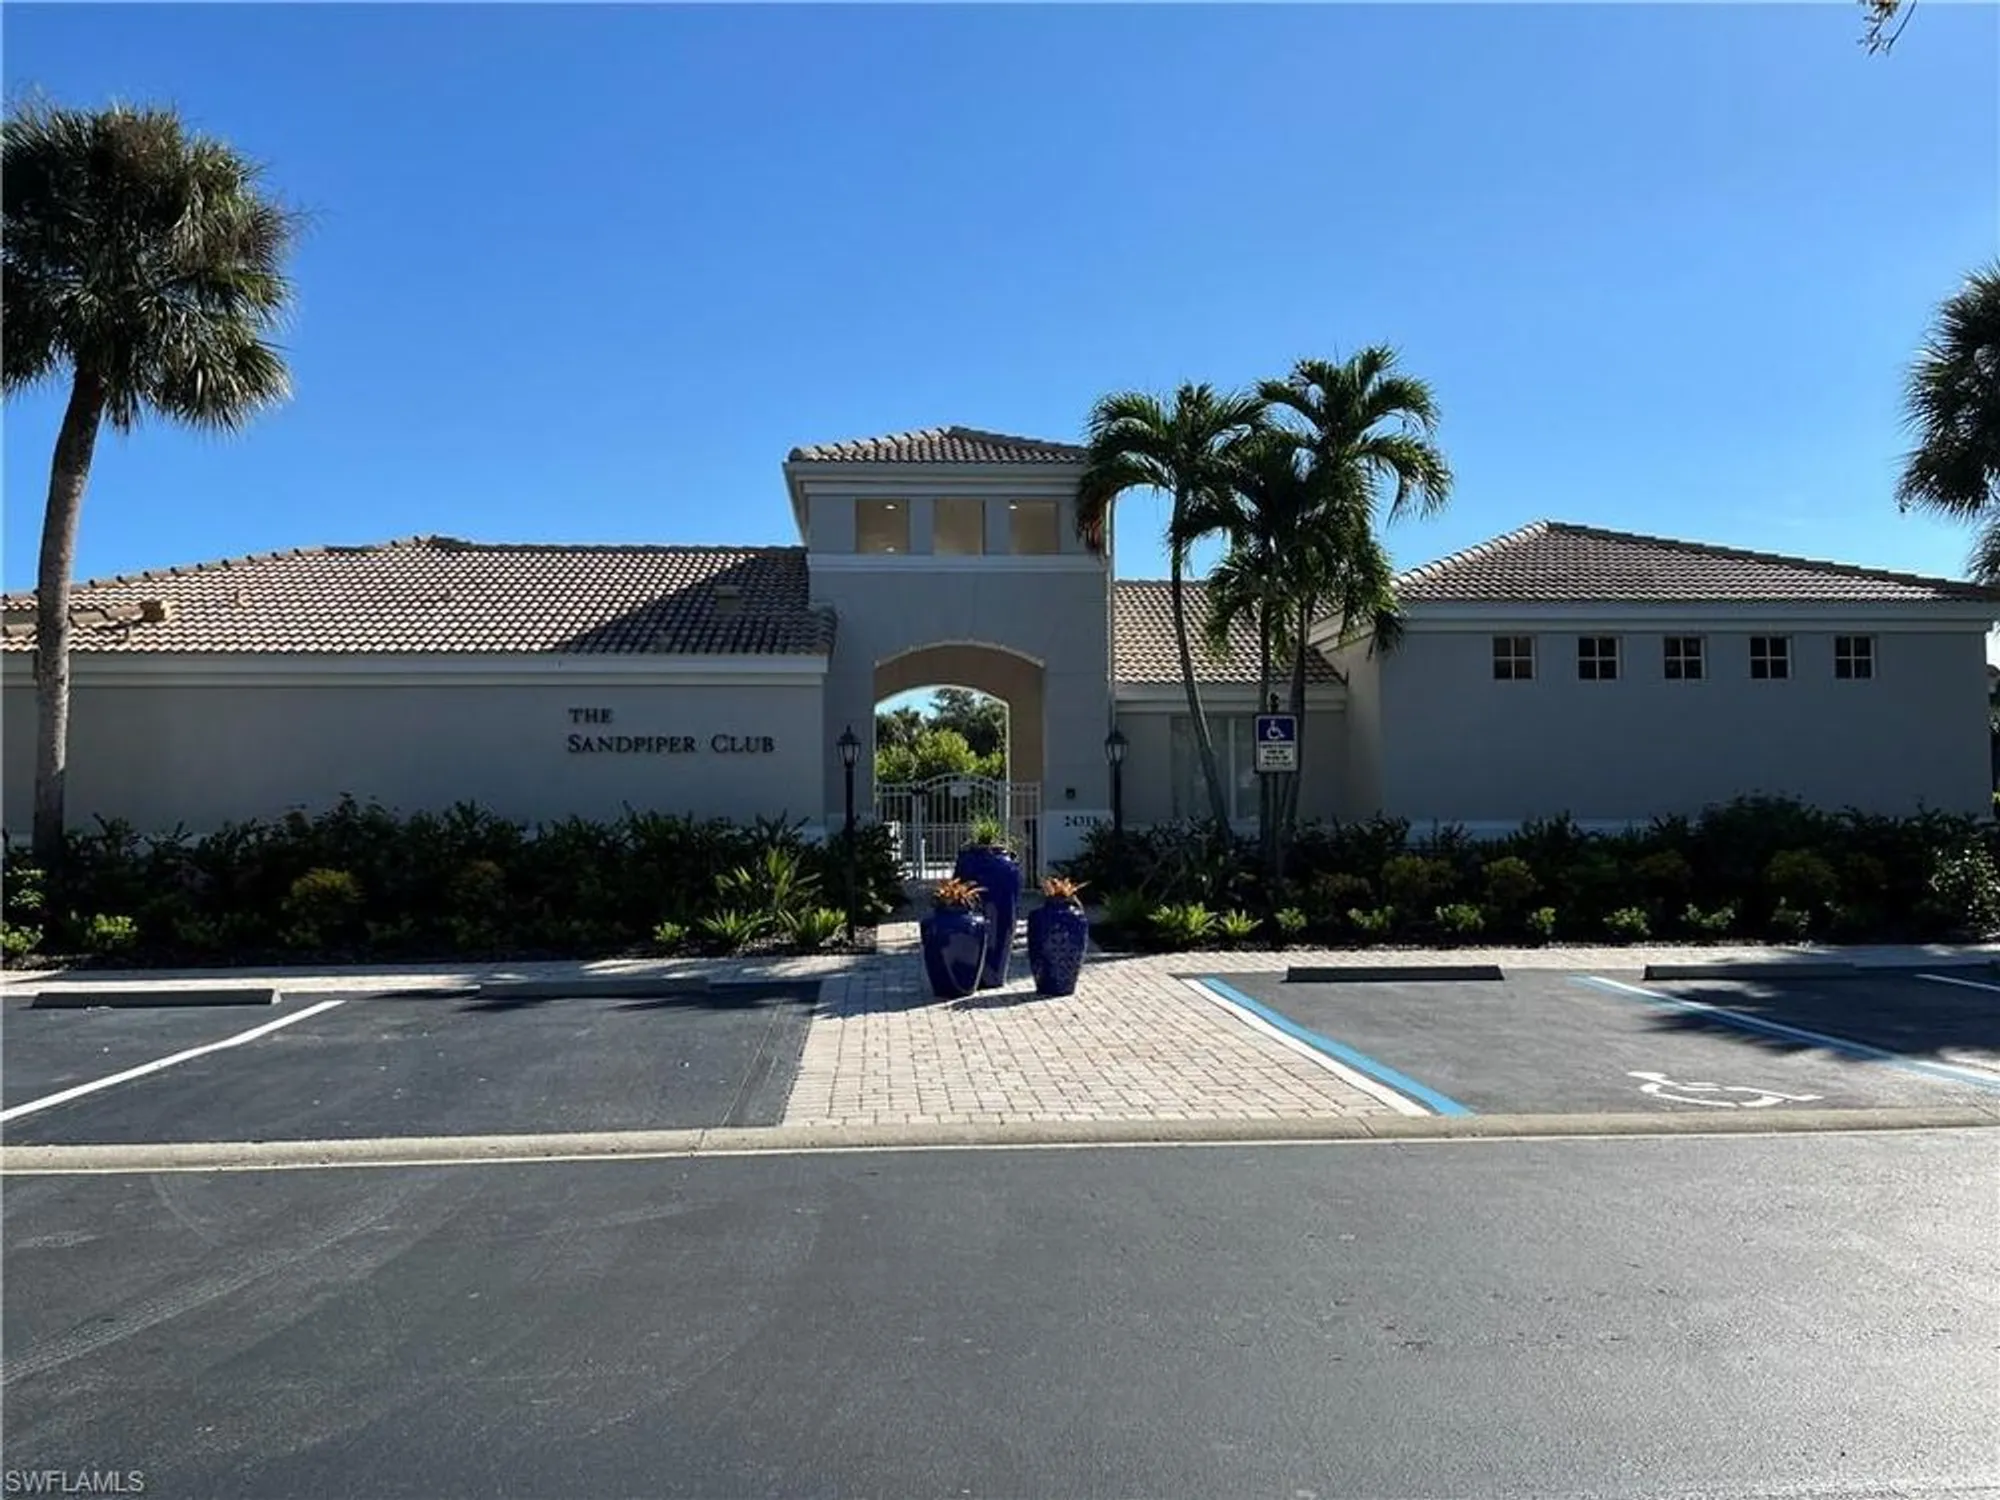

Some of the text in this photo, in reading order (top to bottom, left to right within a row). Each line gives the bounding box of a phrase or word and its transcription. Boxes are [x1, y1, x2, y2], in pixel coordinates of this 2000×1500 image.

[568, 707, 613, 724] THE
[567, 733, 775, 753] SANDPIPER CLUB
